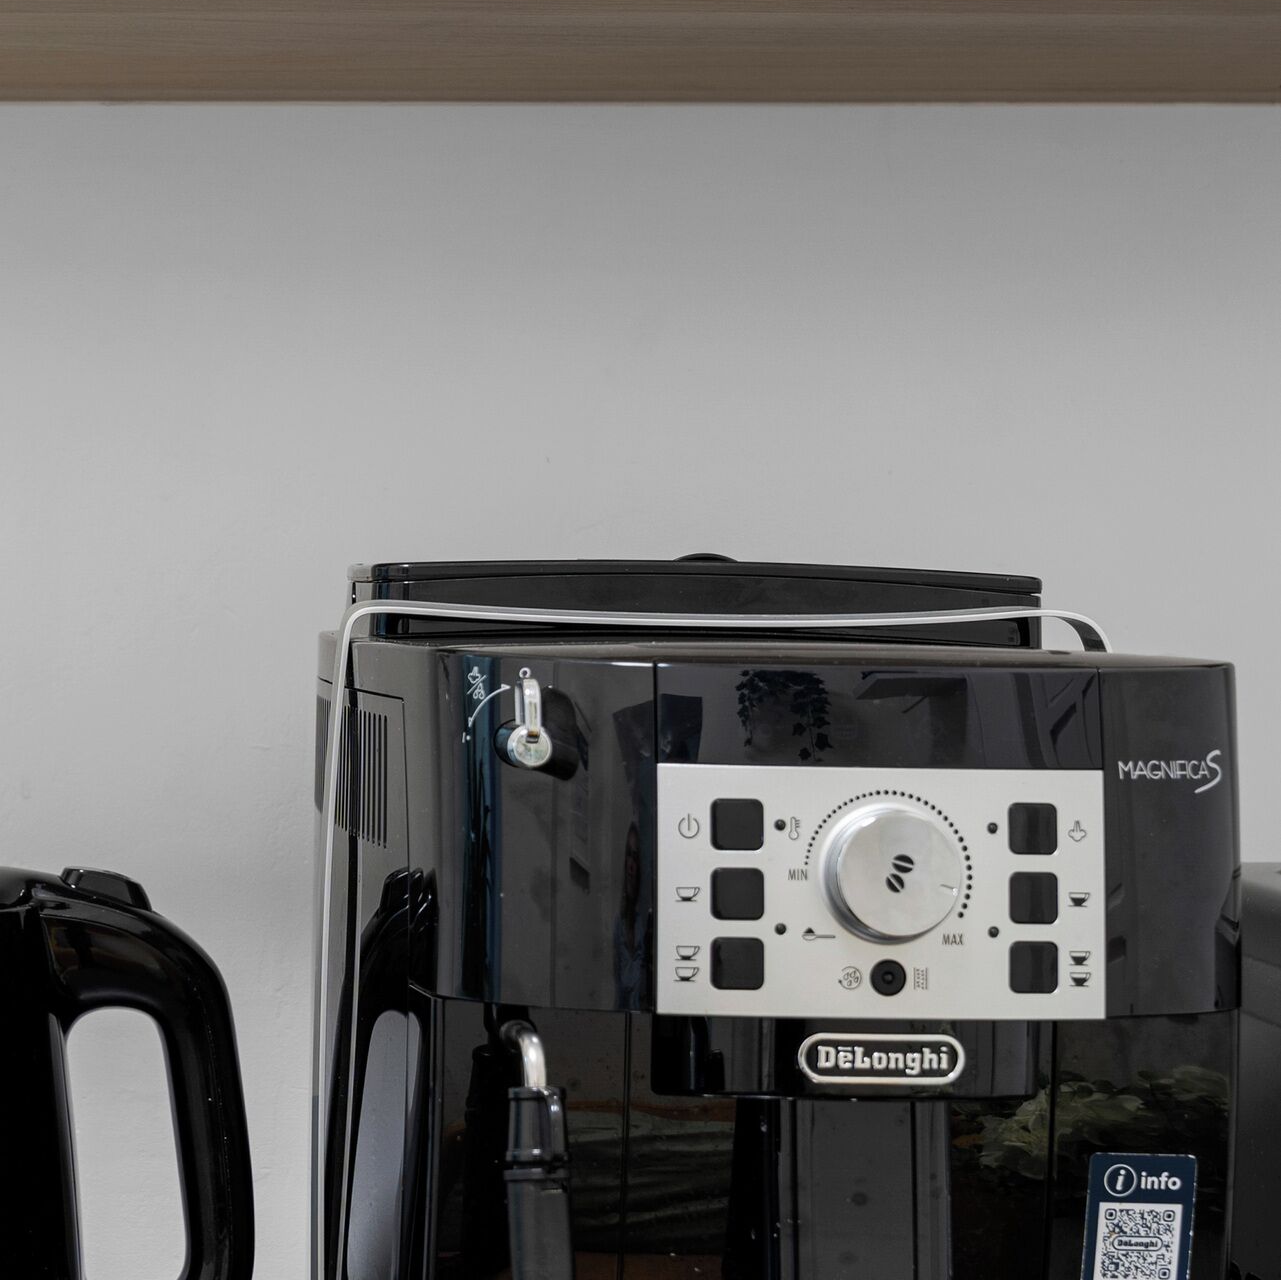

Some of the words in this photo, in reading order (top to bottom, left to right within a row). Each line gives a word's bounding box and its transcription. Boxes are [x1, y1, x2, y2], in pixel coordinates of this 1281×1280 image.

[787, 868, 809, 881] MIN
[941, 933, 964, 946] MAX
[1140, 1171, 1182, 1191] info
